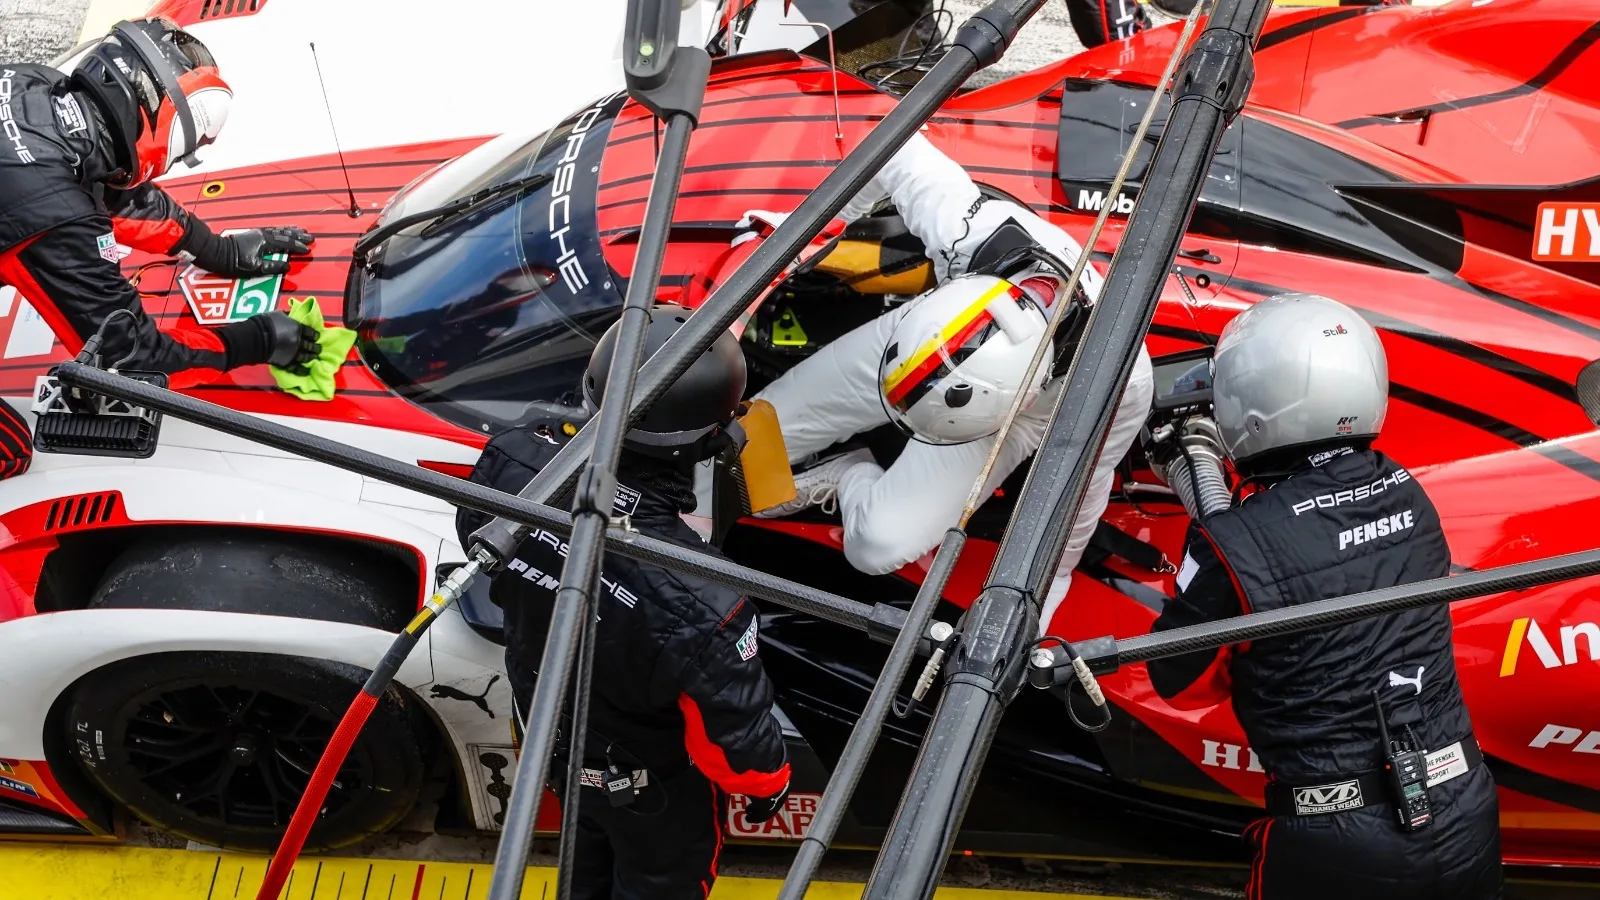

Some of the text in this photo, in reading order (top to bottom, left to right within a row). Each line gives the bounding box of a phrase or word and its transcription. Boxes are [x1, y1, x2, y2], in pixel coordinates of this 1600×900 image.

[0, 69, 36, 164] PORSCHE
[1323, 324, 1348, 337] Stilo
[1292, 468, 1411, 516] PORSCHE
[1338, 510, 1414, 551] PENSKE
[507, 558, 561, 593] PEN
[1436, 751, 1455, 765] PENSKE
[730, 795, 817, 813] HER
[1298, 796, 1361, 813] MECHANIX WEAR
